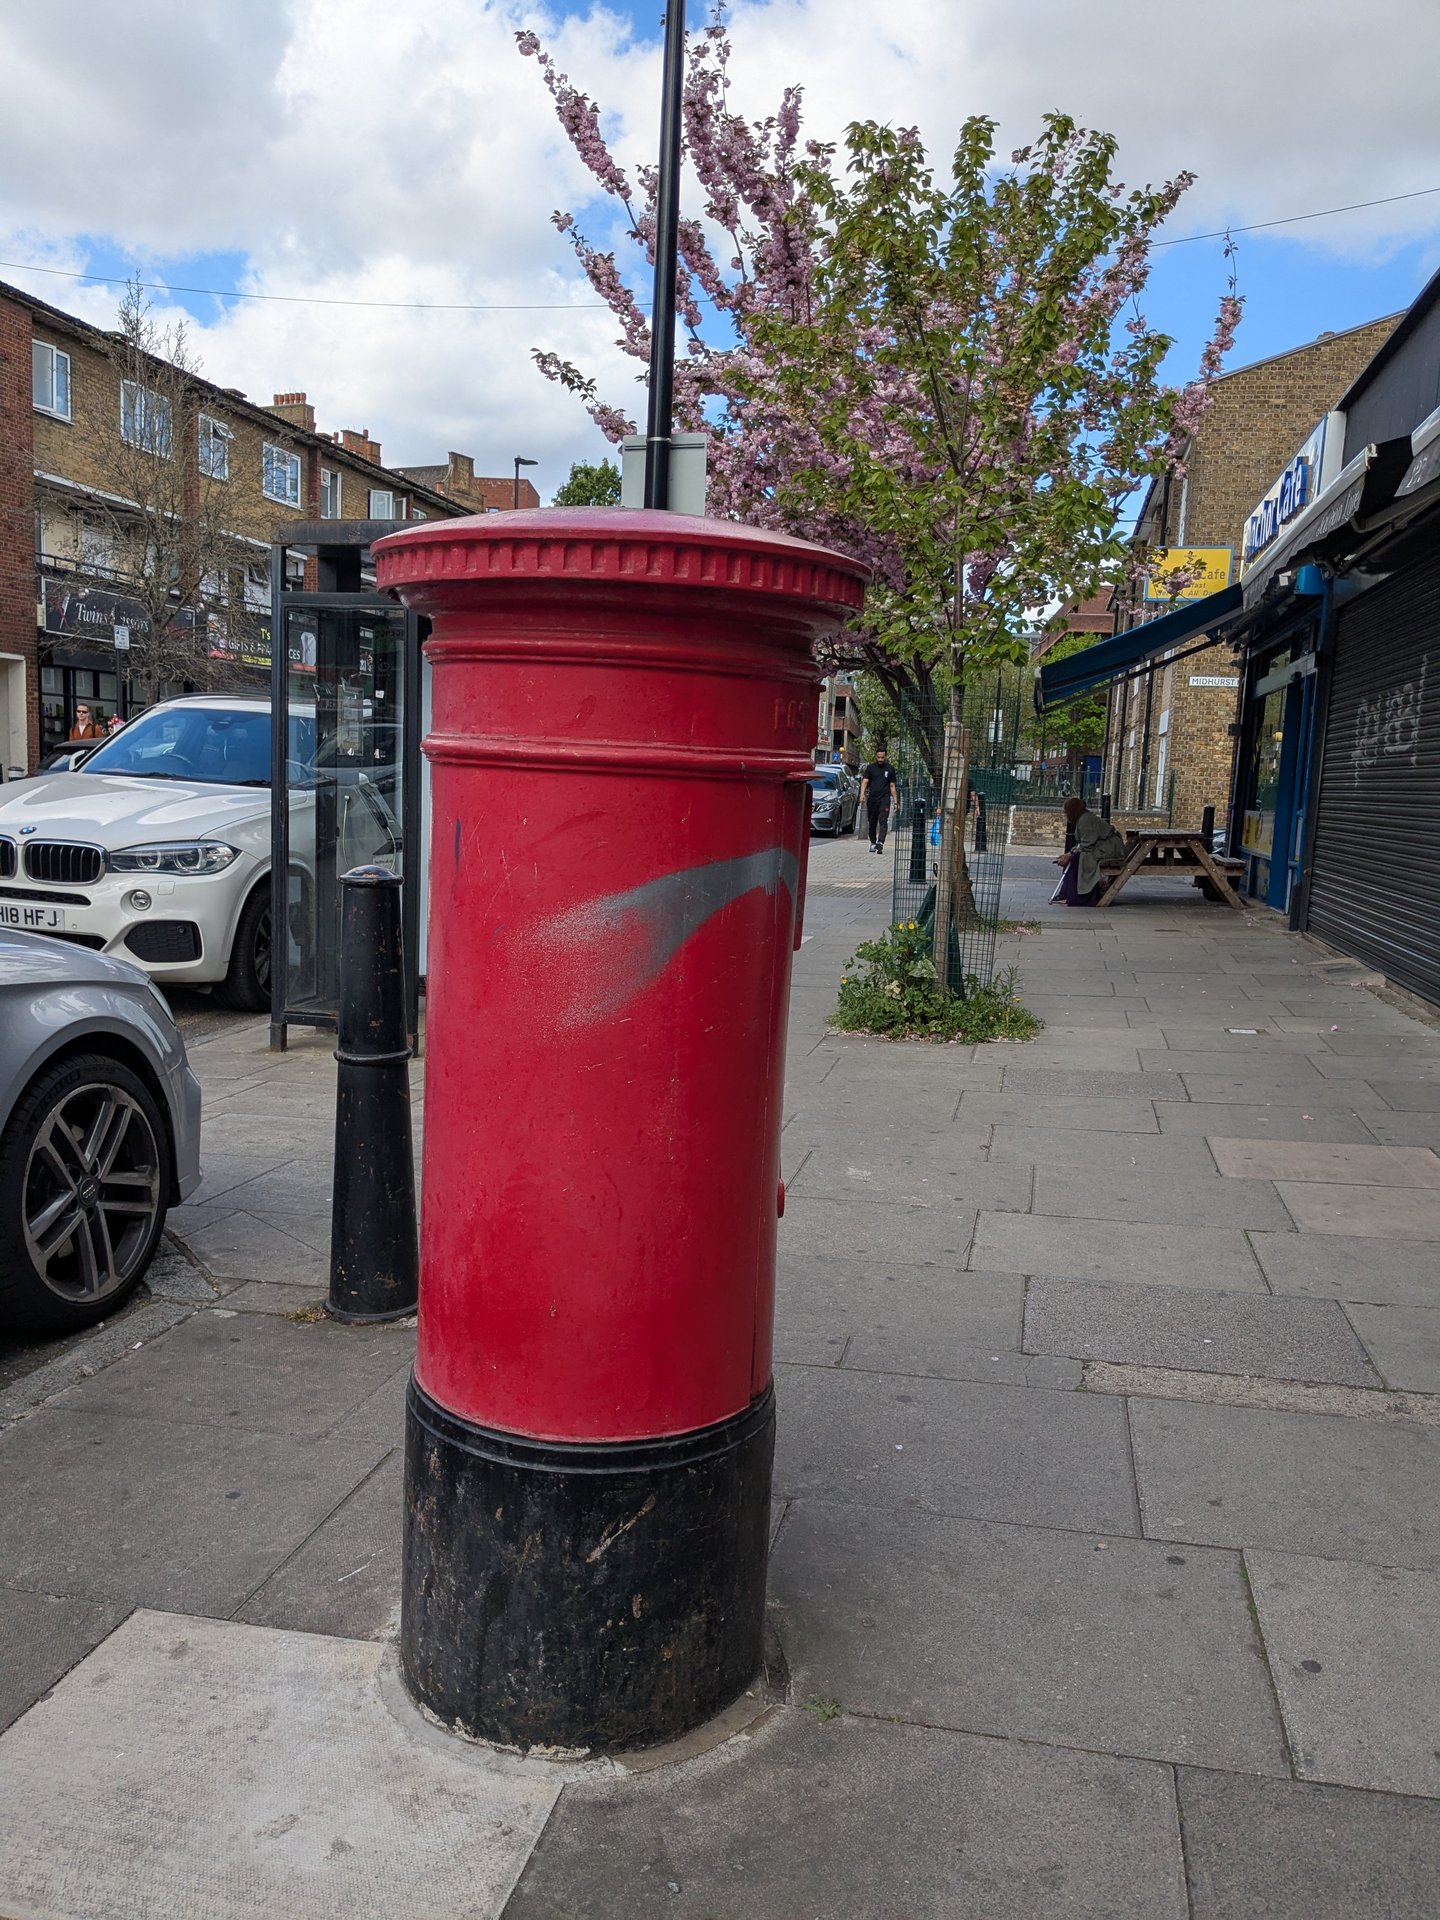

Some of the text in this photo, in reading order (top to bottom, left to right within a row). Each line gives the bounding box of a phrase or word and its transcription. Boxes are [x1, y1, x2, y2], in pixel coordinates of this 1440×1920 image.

[75, 602, 108, 624] Twins
[1192, 677, 1235, 686] MIDHURST
[24, 908, 58, 927] HFJ
